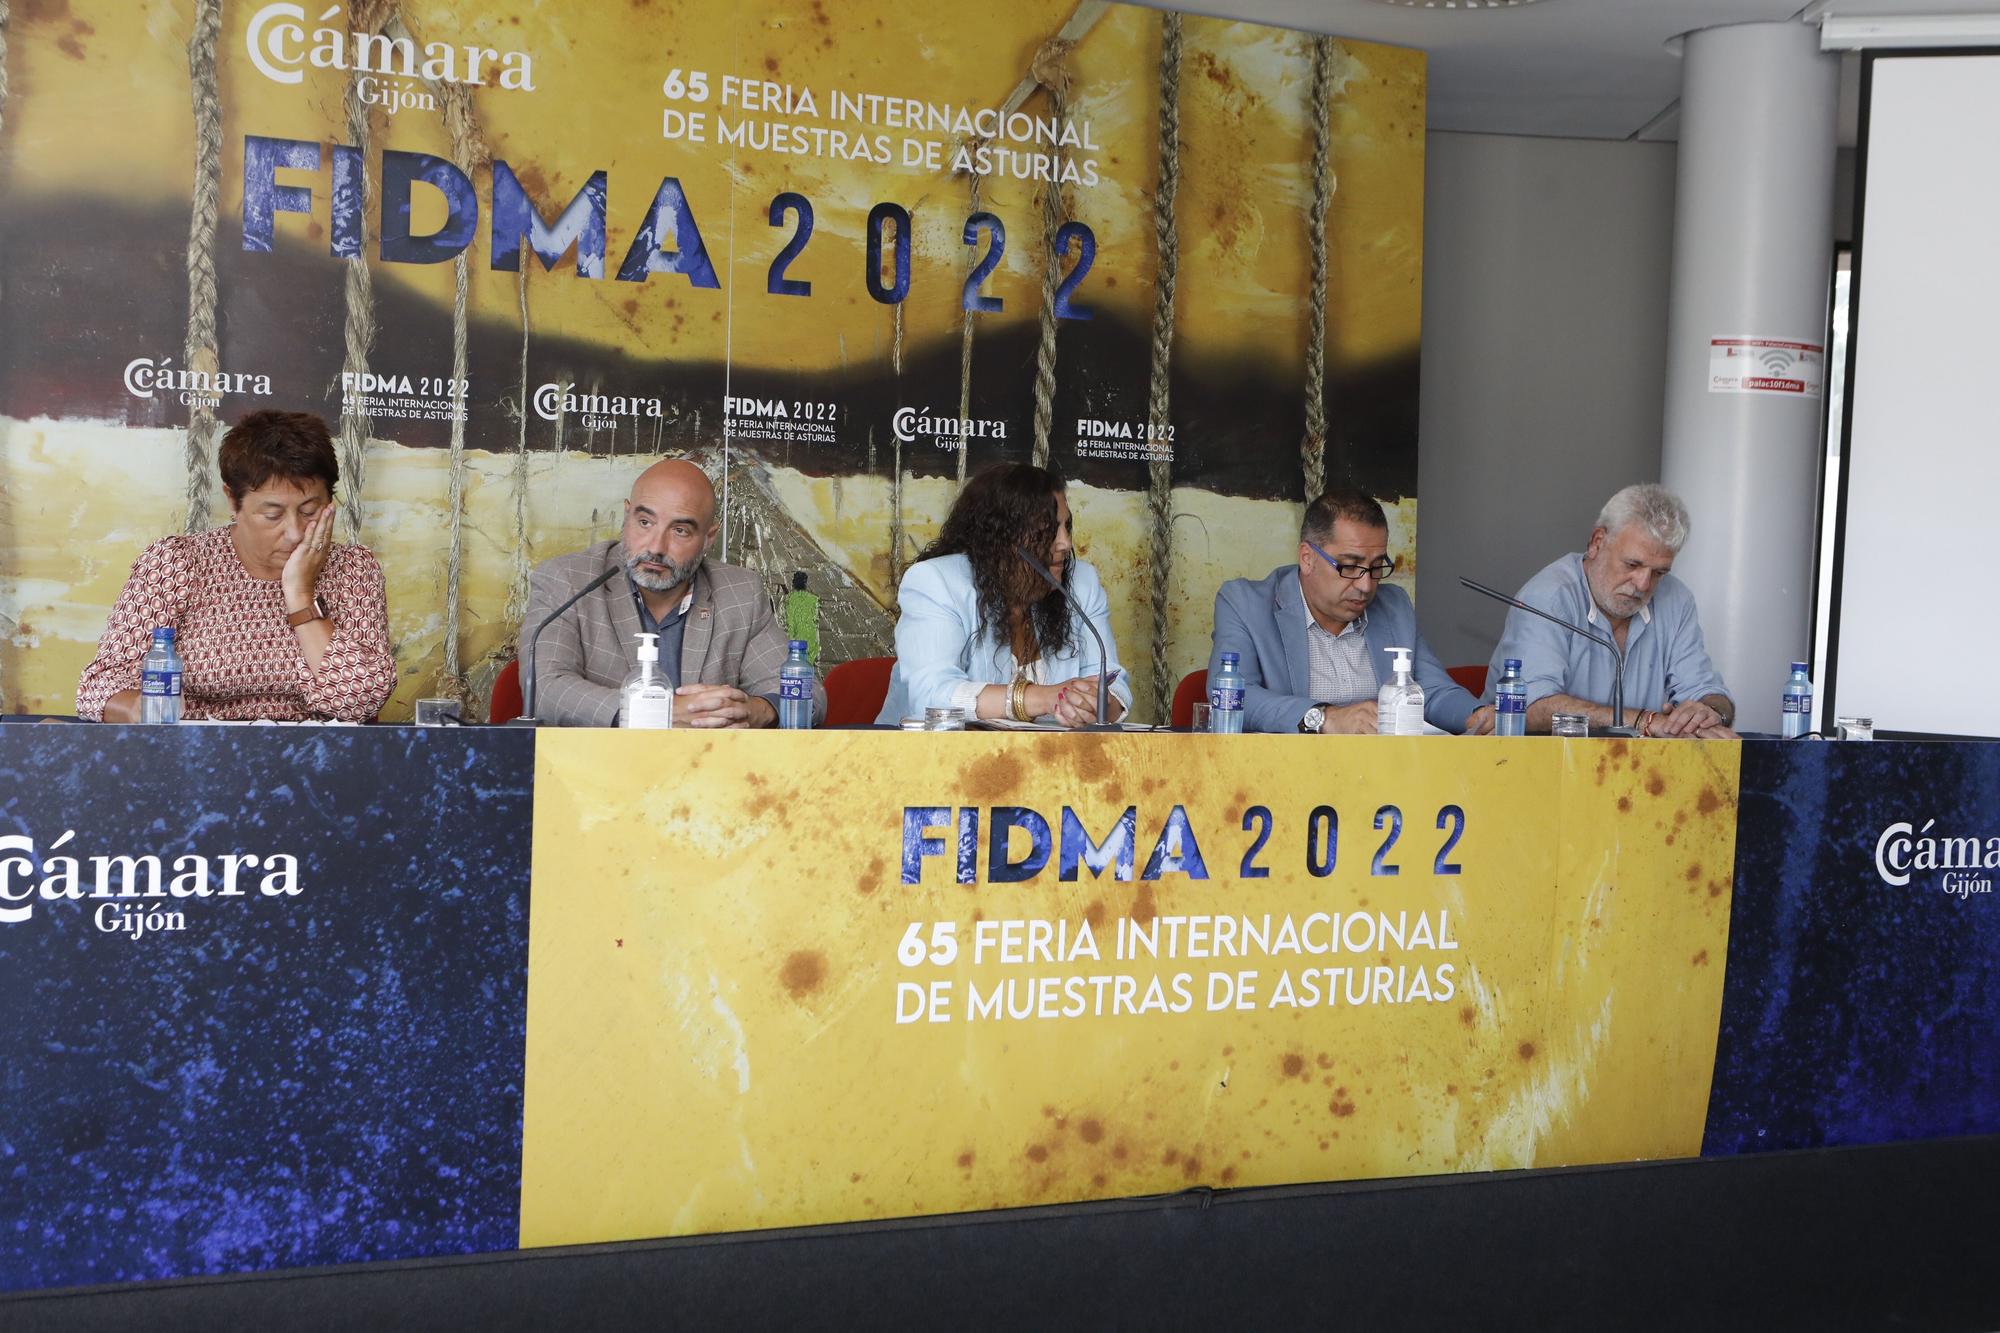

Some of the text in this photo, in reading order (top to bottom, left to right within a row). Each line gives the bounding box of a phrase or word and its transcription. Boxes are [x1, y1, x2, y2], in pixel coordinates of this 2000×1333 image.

[356, 76, 436, 114] Gijón
[663, 69, 1099, 151] 65 FERIA INTERNACIONAL
[663, 109, 1099, 187] DE MUESTRAS DE ASTURIAS
[242, 135, 1097, 320] FIDMA 2022
[342, 372, 470, 398] FIDMA 2022
[179, 391, 221, 410] Gijón
[357, 396, 386, 406] FERIA
[388, 398, 468, 411] INTERNACIONAL
[723, 395, 837, 420] FIDMA 2022
[342, 406, 468, 421] DE MUESTRAS DE ASTURIAS
[581, 413, 617, 432] Gijón
[723, 419, 836, 433] 65 FERIA INTERNACIONAL
[723, 427, 836, 442] DE MUESTRAS DE ASTURIAS
[1077, 419, 1175, 441] FIDMA 2022
[935, 435, 968, 452] Gijón
[1077, 439, 1174, 453] 65 FERIA INTERNACIONAL
[1077, 449, 1174, 462] DE MUESTRAS DE ASTURIAS
[900, 804, 1466, 884] FIDMA 2022
[1875, 818, 2000, 886] Cáma
[1942, 871, 1992, 900] Gijón
[94, 902, 187, 940] Gijón
[897, 910, 1458, 967] 65 FERIA INTERNACIONAL
[896, 963, 1455, 1024] DE MUESTRAS DE ASTURIAS
